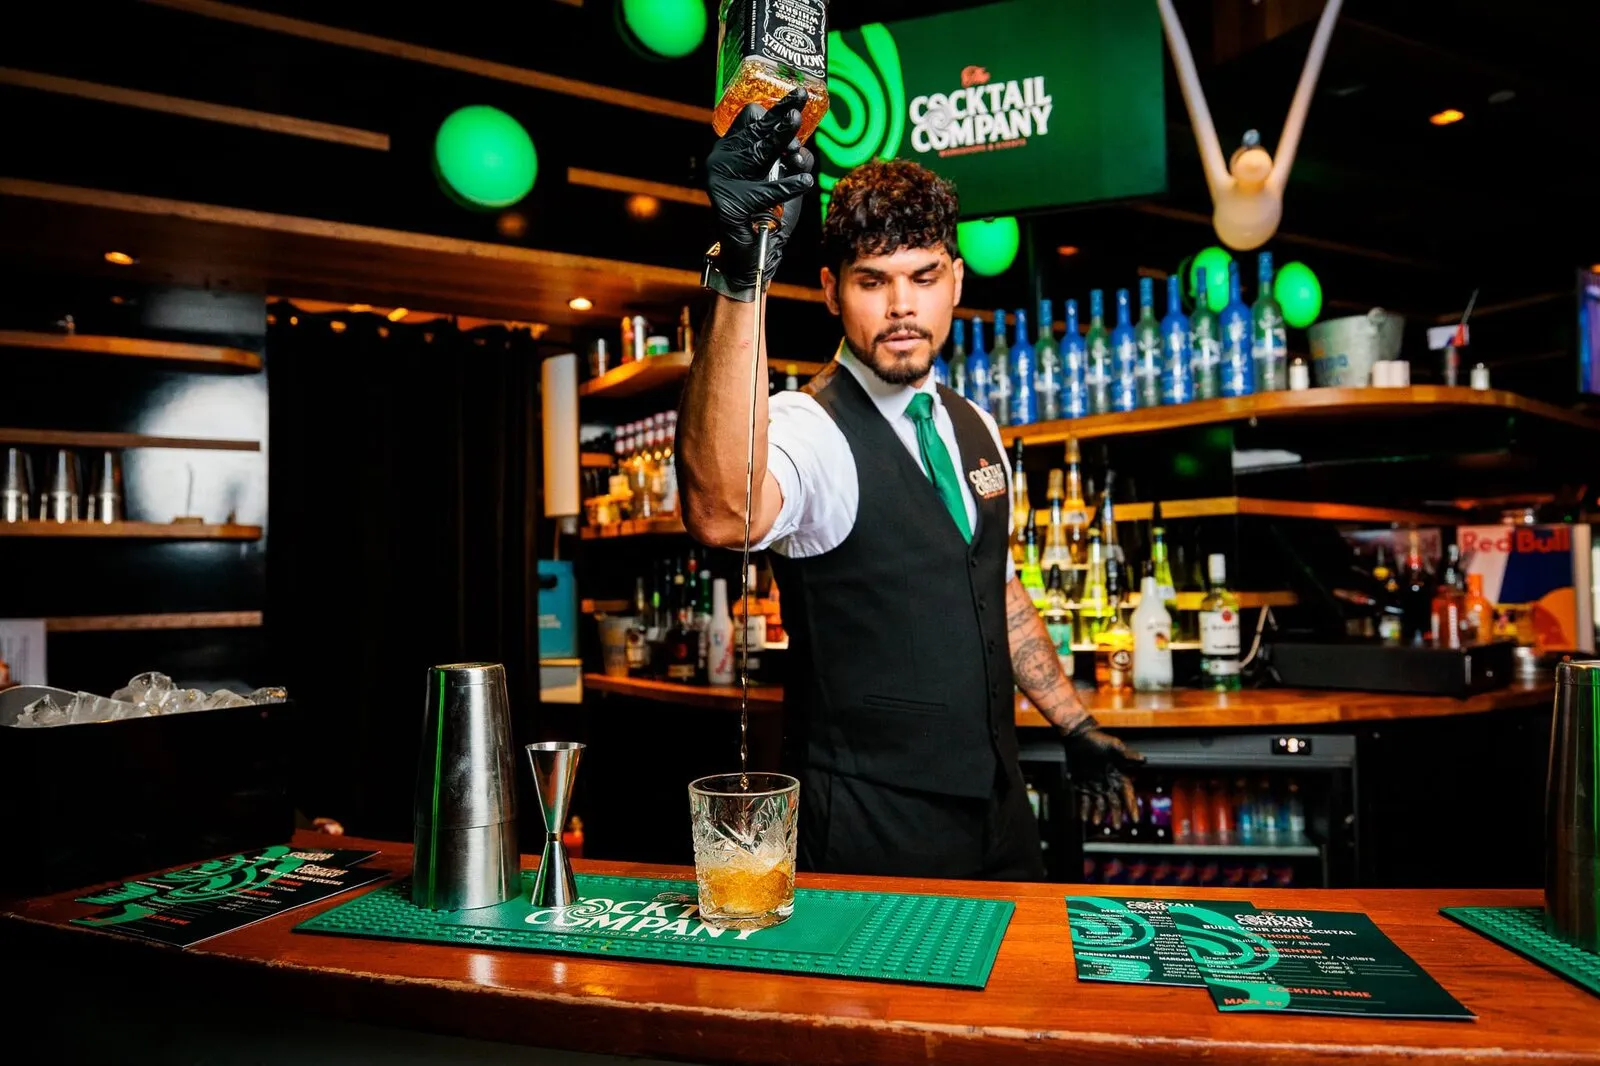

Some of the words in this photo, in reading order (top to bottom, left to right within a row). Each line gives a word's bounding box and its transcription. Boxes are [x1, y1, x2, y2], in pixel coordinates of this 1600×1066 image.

[772, 1, 820, 25] WHISKEY
[762, 33, 803, 66] DANIEL'S
[802, 53, 825, 69] JACK
[909, 75, 1053, 126] COCKTAIL
[911, 104, 1054, 154] COMPANY
[1463, 530, 1512, 553] Red
[1517, 528, 1570, 553] Bull
[1234, 914, 1313, 924] COCKTAIL
[1237, 919, 1314, 928] COMPANY
[1302, 928, 1358, 936] COCKTAIL
[1253, 946, 1323, 954] ELEMENTEN
[1253, 952, 1329, 960] Smaakmakers
[1336, 955, 1376, 963] Vullers
[1268, 985, 1331, 996] COCKTAIL
[1332, 989, 1372, 998] NAME
